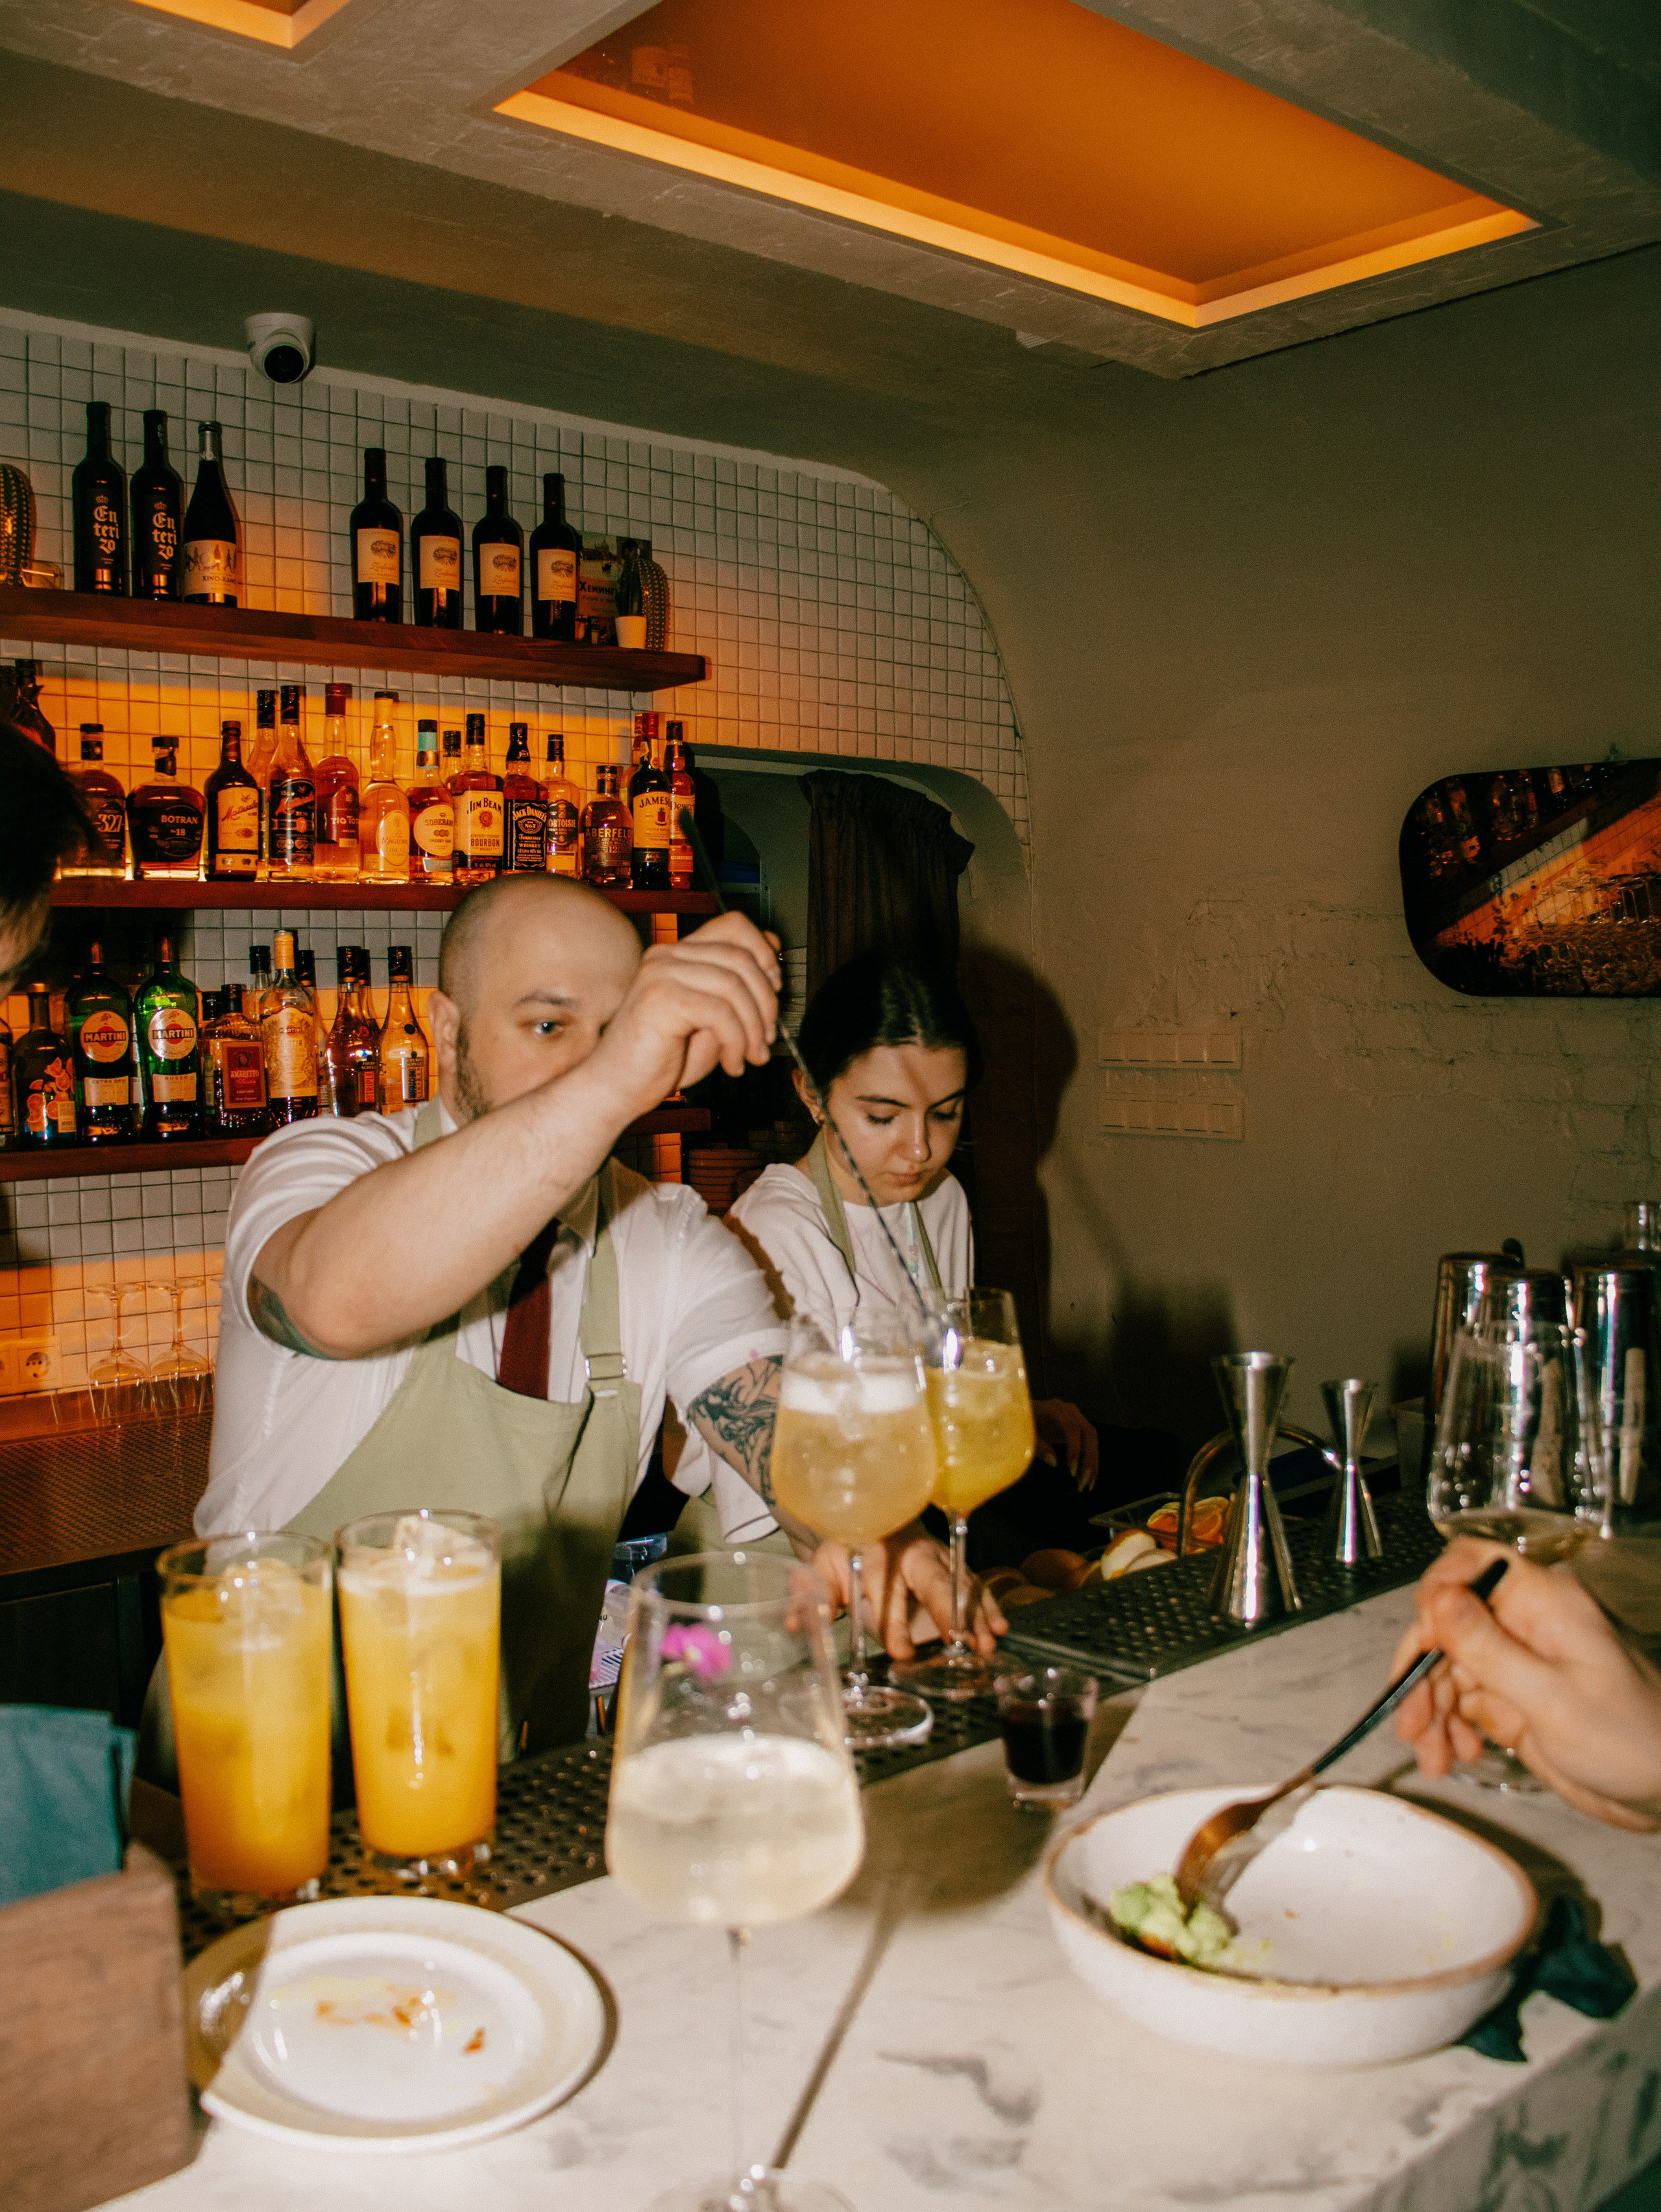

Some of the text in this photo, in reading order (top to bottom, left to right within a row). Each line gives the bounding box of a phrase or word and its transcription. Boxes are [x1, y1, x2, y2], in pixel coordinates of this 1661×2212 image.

[93, 505, 117, 523] En
[152, 512, 175, 529] En
[93, 523, 119, 539] teri
[152, 529, 177, 545] teri
[467, 797, 502, 815] JIM BEAM
[639, 796, 670, 808] JAMES
[161, 815, 198, 824] BOTRAN
[513, 808, 526, 821] JACK
[470, 838, 500, 847] BOURBON
[84, 1031, 126, 1042] MARTINI
